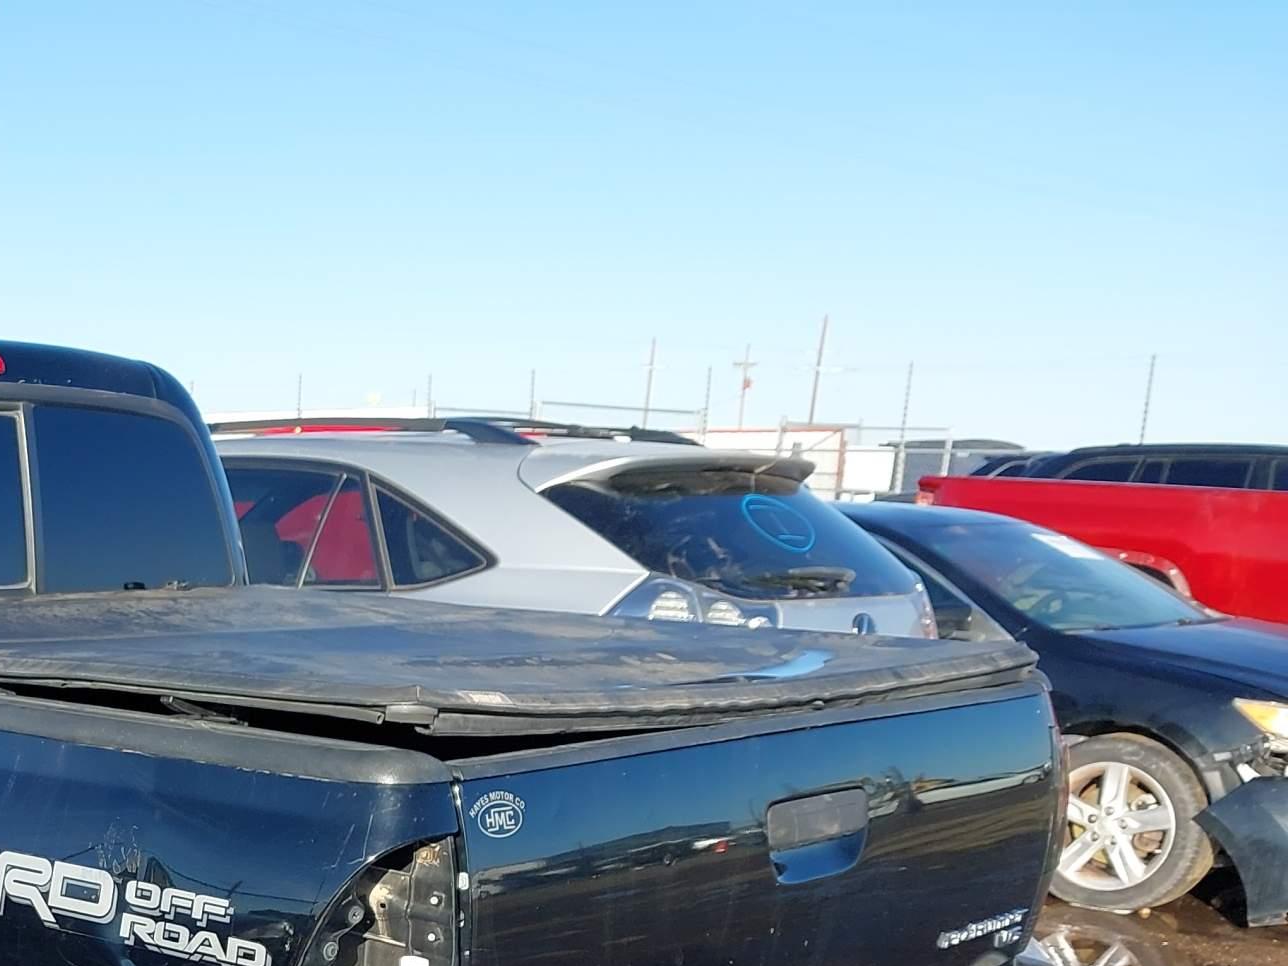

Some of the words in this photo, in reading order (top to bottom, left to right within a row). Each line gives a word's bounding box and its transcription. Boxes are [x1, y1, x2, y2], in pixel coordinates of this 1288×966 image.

[469, 794, 489, 818] HAYES
[488, 790, 514, 803] MOTOR
[485, 806, 516, 832] HMC
[125, 879, 234, 927] OFF
